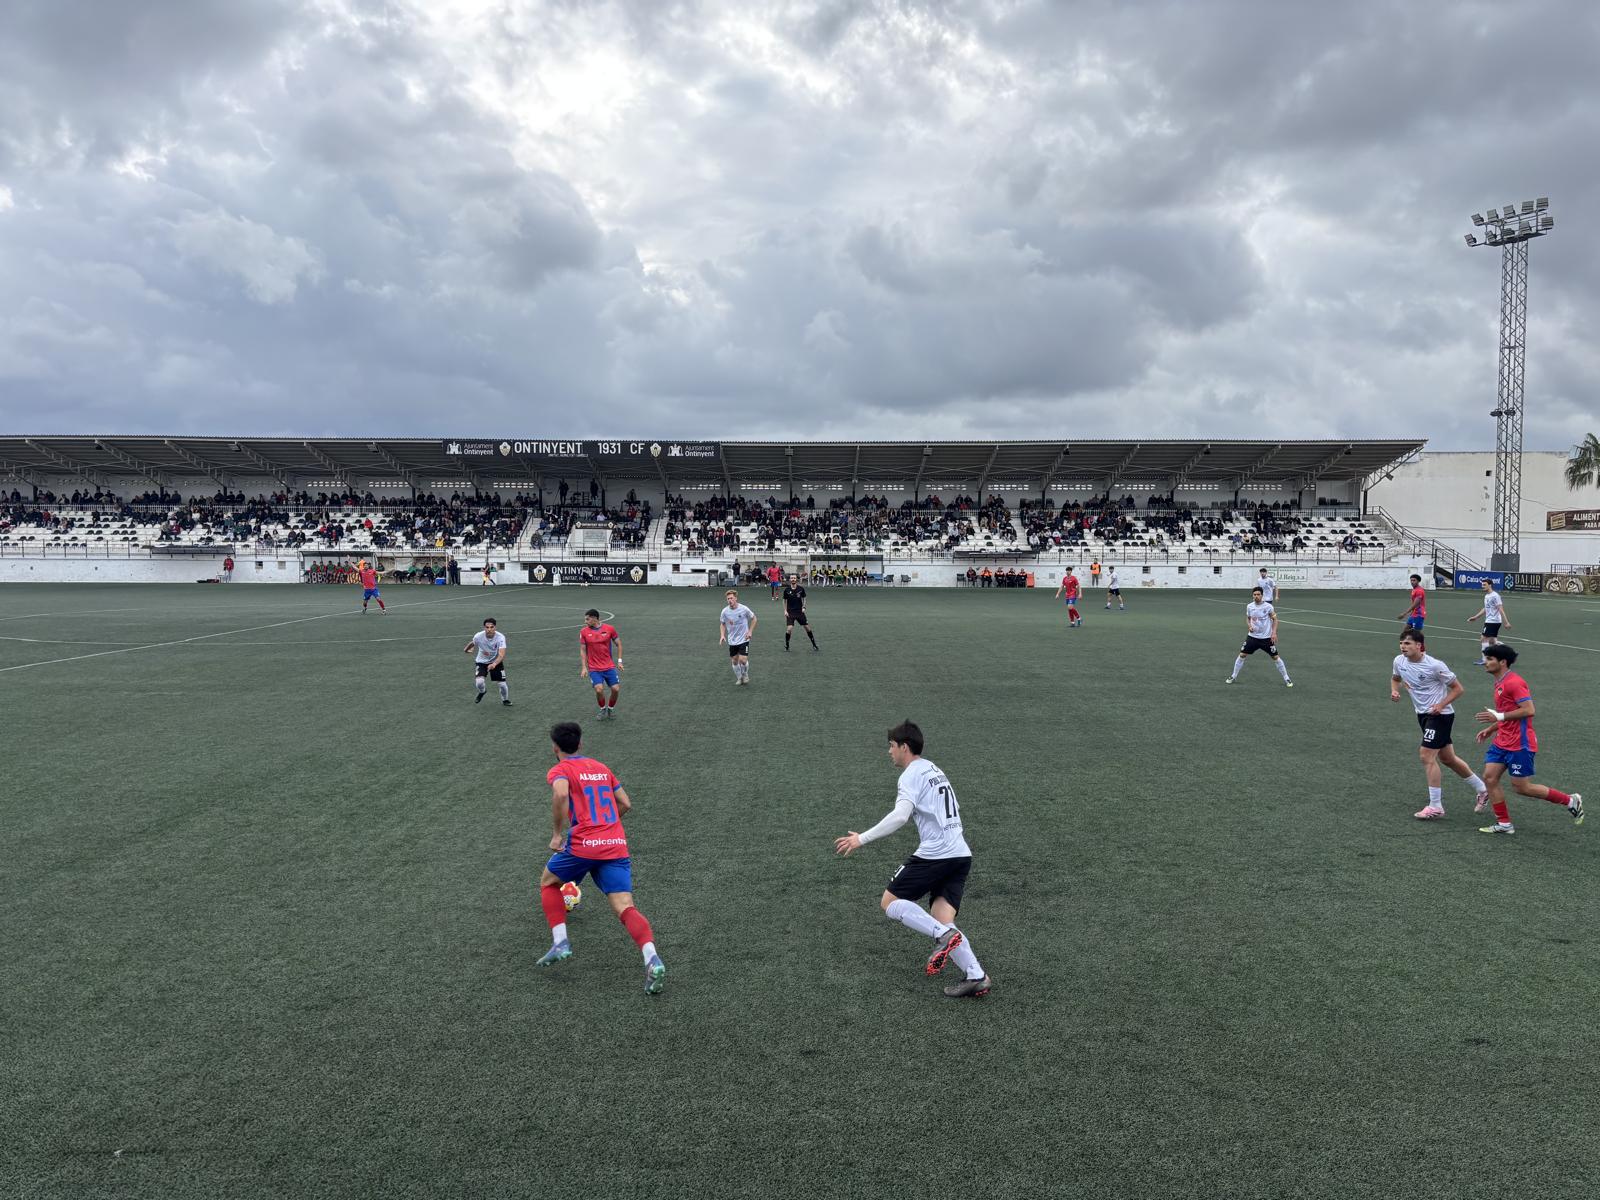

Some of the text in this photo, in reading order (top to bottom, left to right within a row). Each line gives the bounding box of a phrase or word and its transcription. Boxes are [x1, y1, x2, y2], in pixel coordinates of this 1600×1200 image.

[463, 448, 494, 456] Ontinyent
[514, 442, 646, 455] ONTINYENT 1931 CF
[685, 450, 715, 458] Ontinyent
[600, 567, 615, 575] 1931
[1424, 728, 1436, 740] 23
[580, 773, 608, 781] ALBERT
[584, 786, 617, 824] 15
[939, 785, 957, 818] 21
